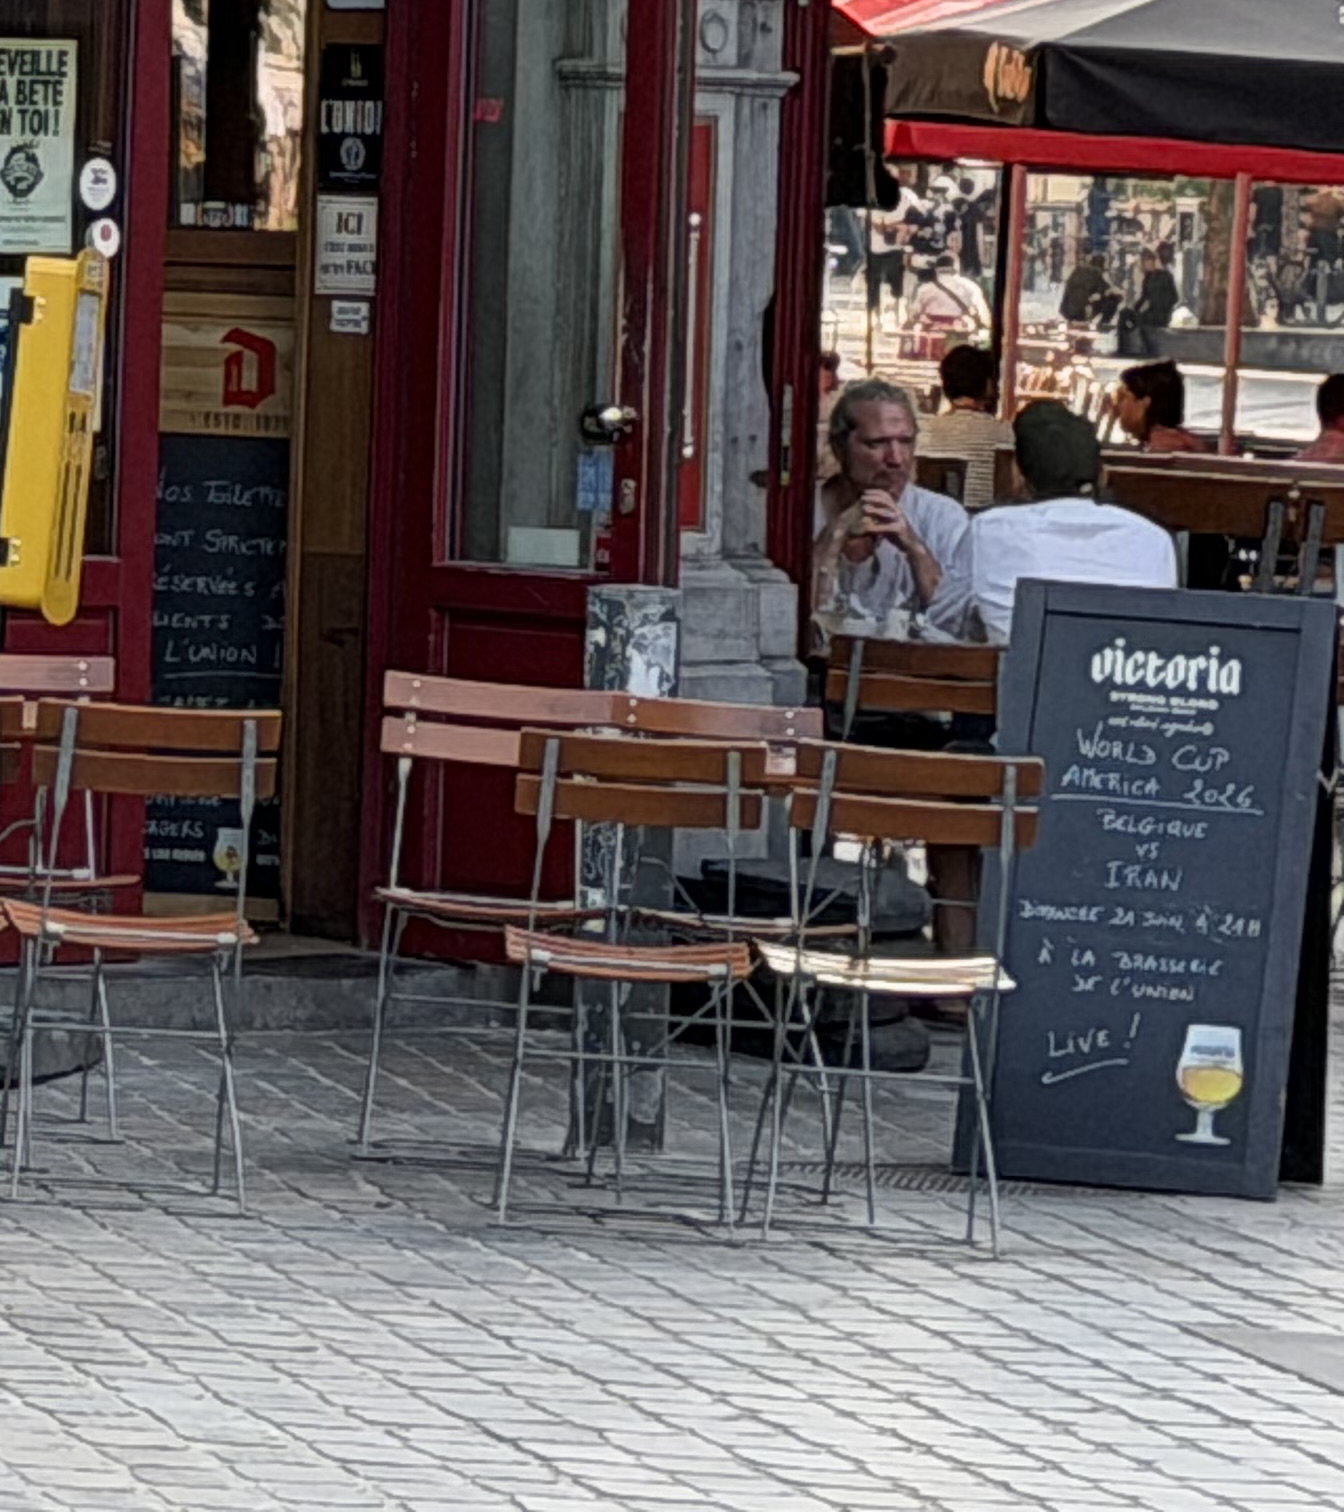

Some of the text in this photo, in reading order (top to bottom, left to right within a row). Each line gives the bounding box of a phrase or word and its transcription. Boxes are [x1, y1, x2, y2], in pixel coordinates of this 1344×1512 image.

[164, 637, 257, 665] L'UNION
[1091, 638, 1242, 695] victoria
[1077, 721, 1157, 766] WORLD
[1171, 745, 1231, 773] CUP
[1060, 763, 1255, 810] AMERICA 2026
[1095, 807, 1209, 839] BELGIQUE
[1104, 860, 1184, 892] IRAN
[1046, 1027, 1111, 1058] LIVE
